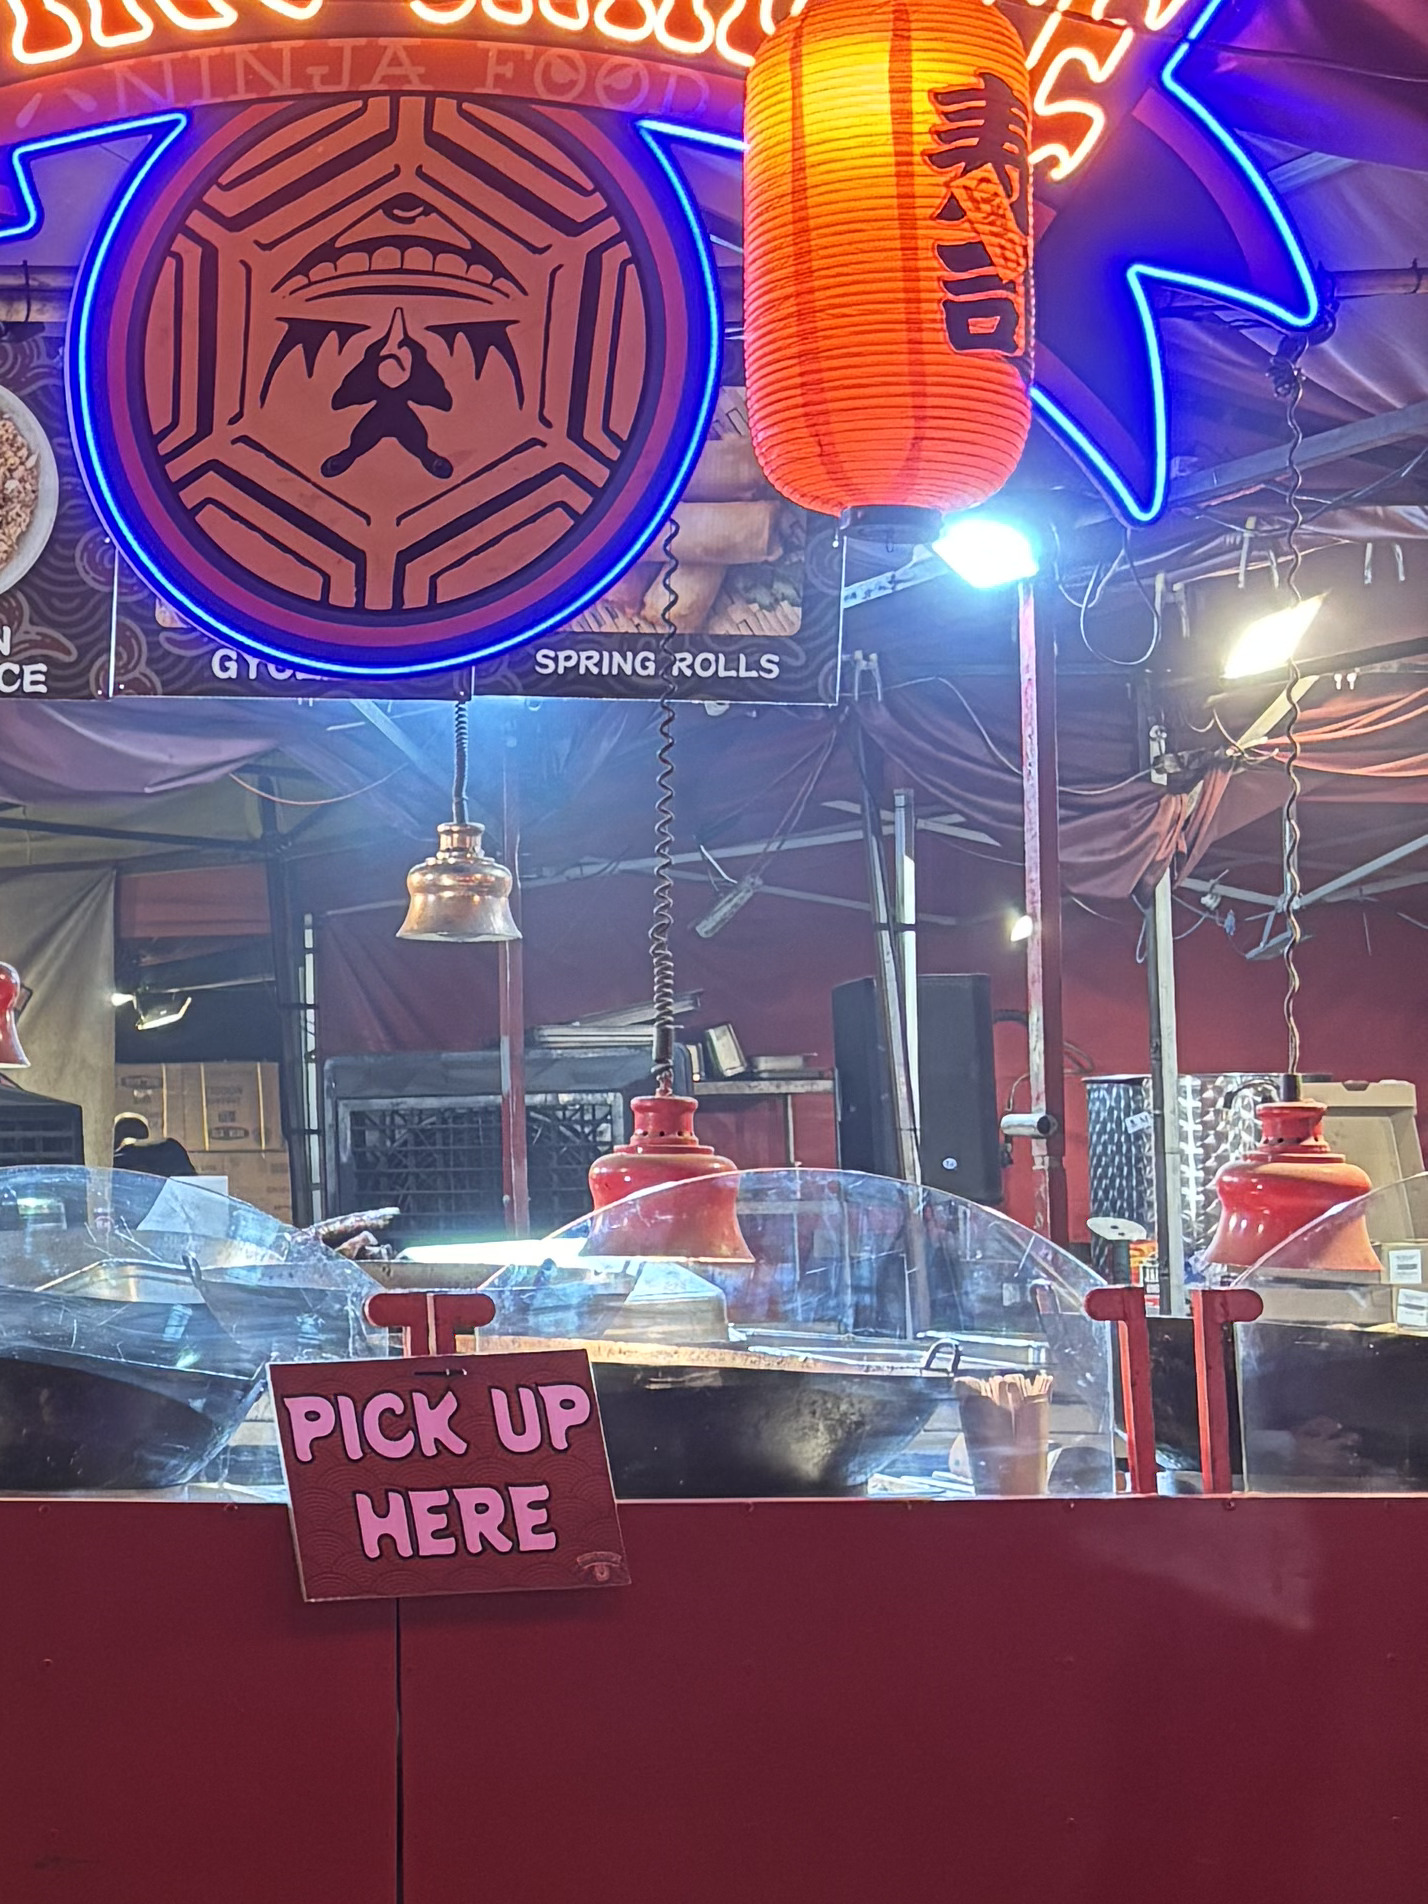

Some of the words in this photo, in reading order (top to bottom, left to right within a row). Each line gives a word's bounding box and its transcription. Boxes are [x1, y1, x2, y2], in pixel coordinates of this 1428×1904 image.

[104, 36, 434, 112] NINJA
[479, 43, 711, 118] FOOD
[534, 648, 656, 677] SPRING
[671, 651, 781, 680] ROLLS
[282, 1389, 469, 1464] PICK
[490, 1382, 592, 1454] UP
[355, 1483, 558, 1560] HERE
